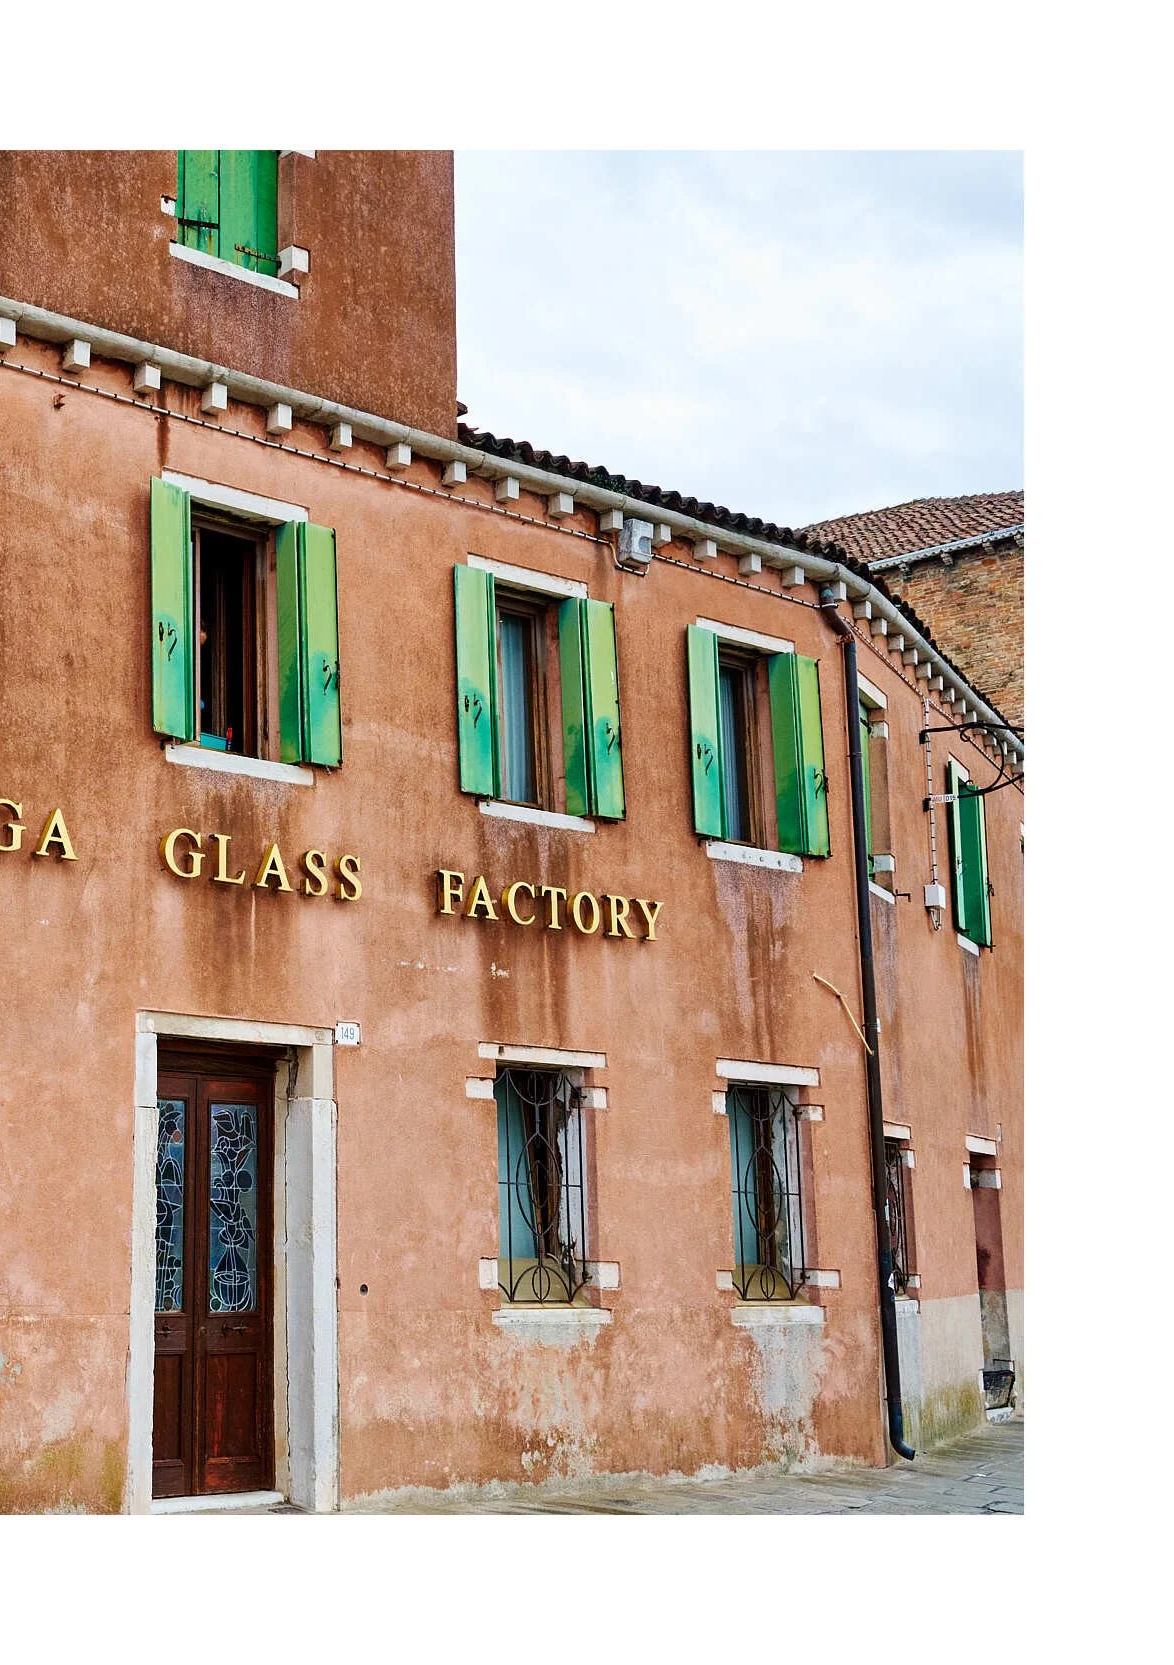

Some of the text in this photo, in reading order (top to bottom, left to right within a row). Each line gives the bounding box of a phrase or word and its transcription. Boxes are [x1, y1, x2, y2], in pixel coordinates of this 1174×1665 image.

[160, 828, 363, 901] GLASS
[437, 869, 665, 941] FACTORY
[341, 1027, 355, 1040] 149
